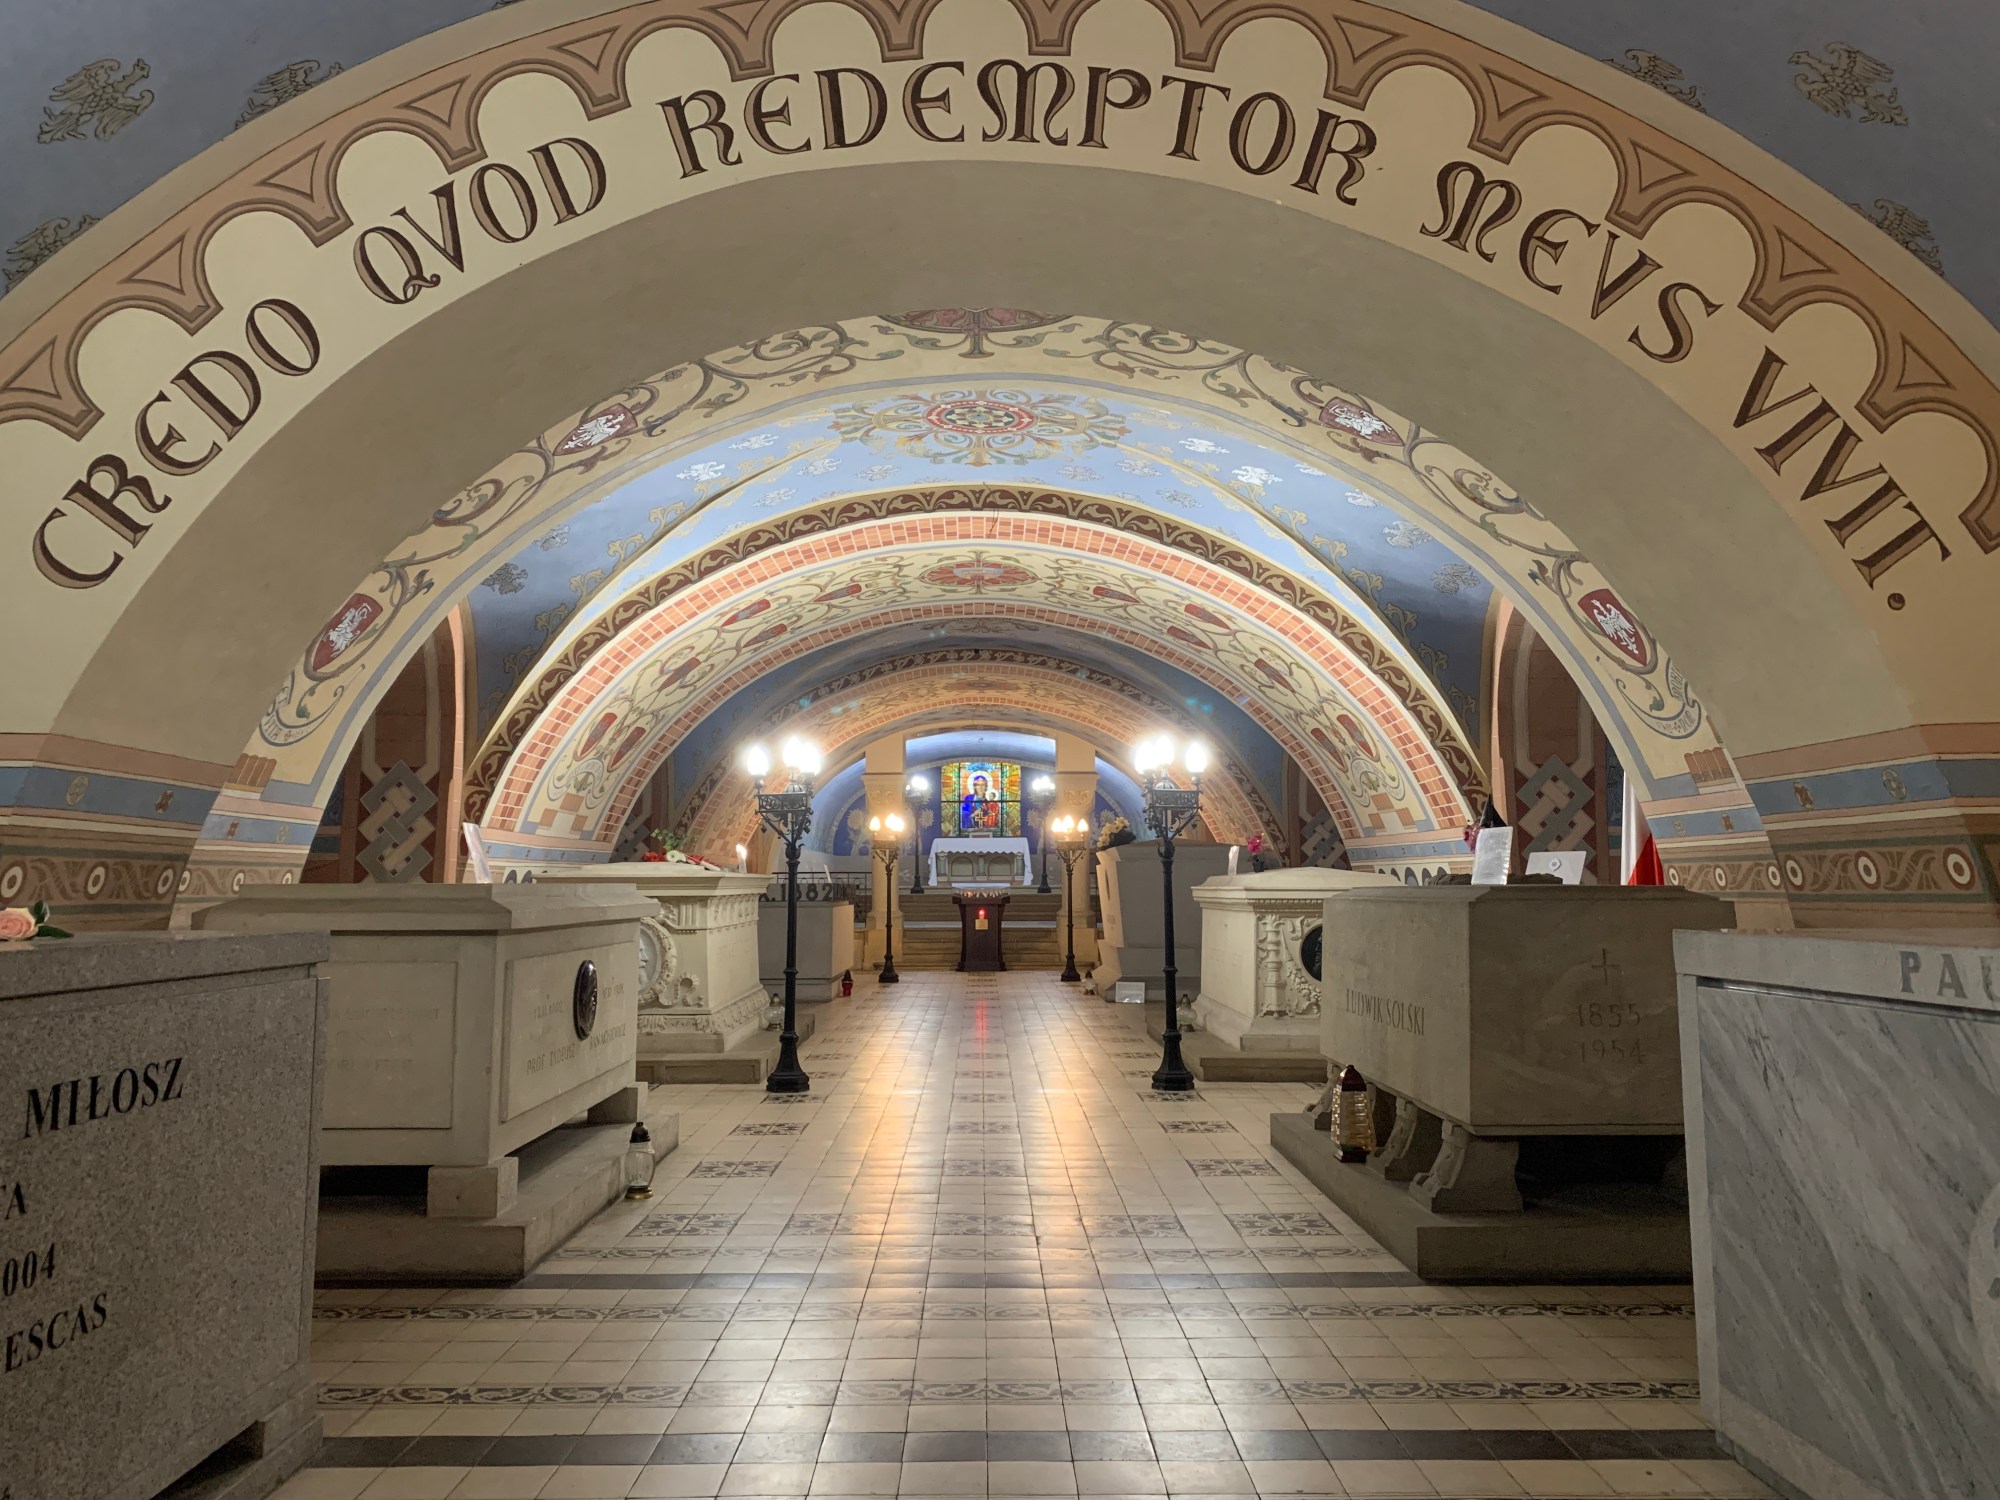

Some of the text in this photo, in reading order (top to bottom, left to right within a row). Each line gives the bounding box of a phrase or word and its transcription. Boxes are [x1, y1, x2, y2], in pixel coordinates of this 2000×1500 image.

[32, 298, 320, 589] CREDO
[353, 137, 607, 305] QVOD
[655, 58, 1377, 207] REDEMPTOR
[1419, 160, 1724, 364] MEVS
[1346, 987, 1425, 1037] LUDWIK SOLSKI
[1577, 1002, 1641, 1028] 1855
[1580, 1038, 1646, 1065] 1954
[20, 1057, 183, 1140] MIŁOSZ
[5, 1291, 107, 1374] ESCAS
